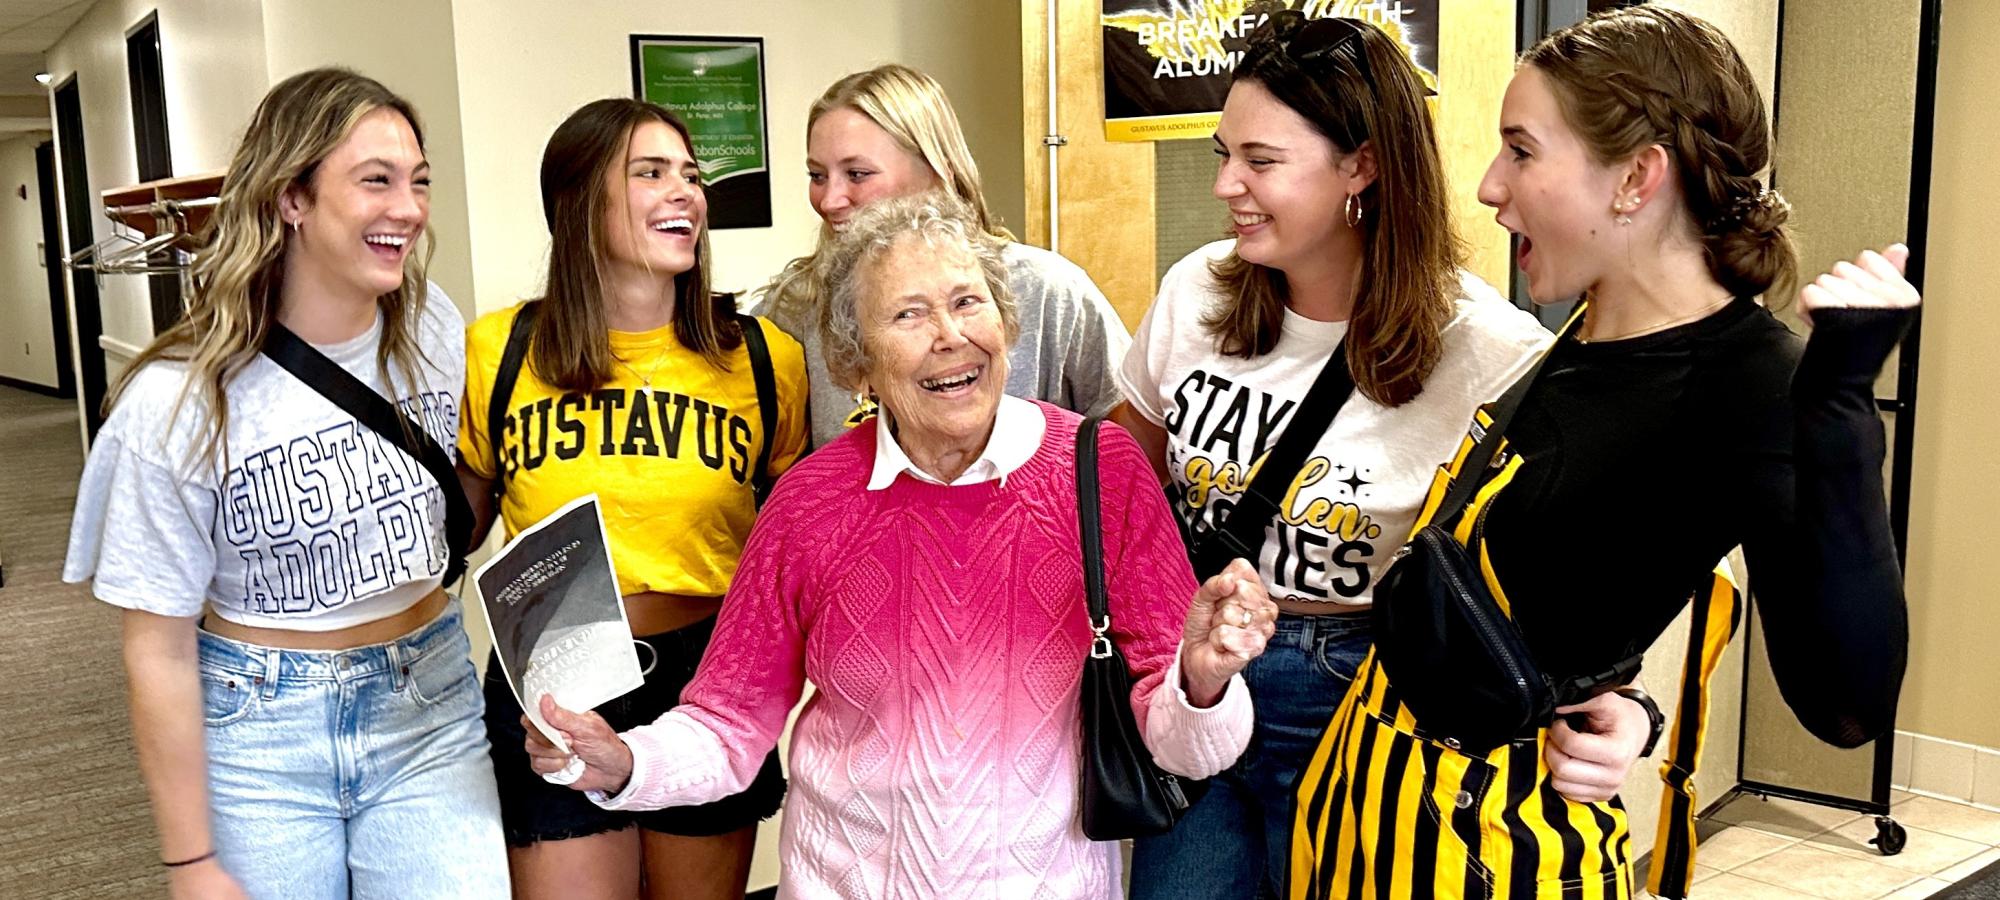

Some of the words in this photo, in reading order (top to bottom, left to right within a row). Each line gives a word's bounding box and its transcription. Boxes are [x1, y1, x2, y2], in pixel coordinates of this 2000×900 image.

[1138, 13, 1270, 46] BREAKF
[1153, 51, 1246, 79] ALUM
[1130, 124, 1166, 133] GUSTAVUS
[1167, 122, 1205, 132] ADOLPHUS
[1165, 369, 1297, 466] STAY
[503, 388, 753, 485] GUSTAVUS
